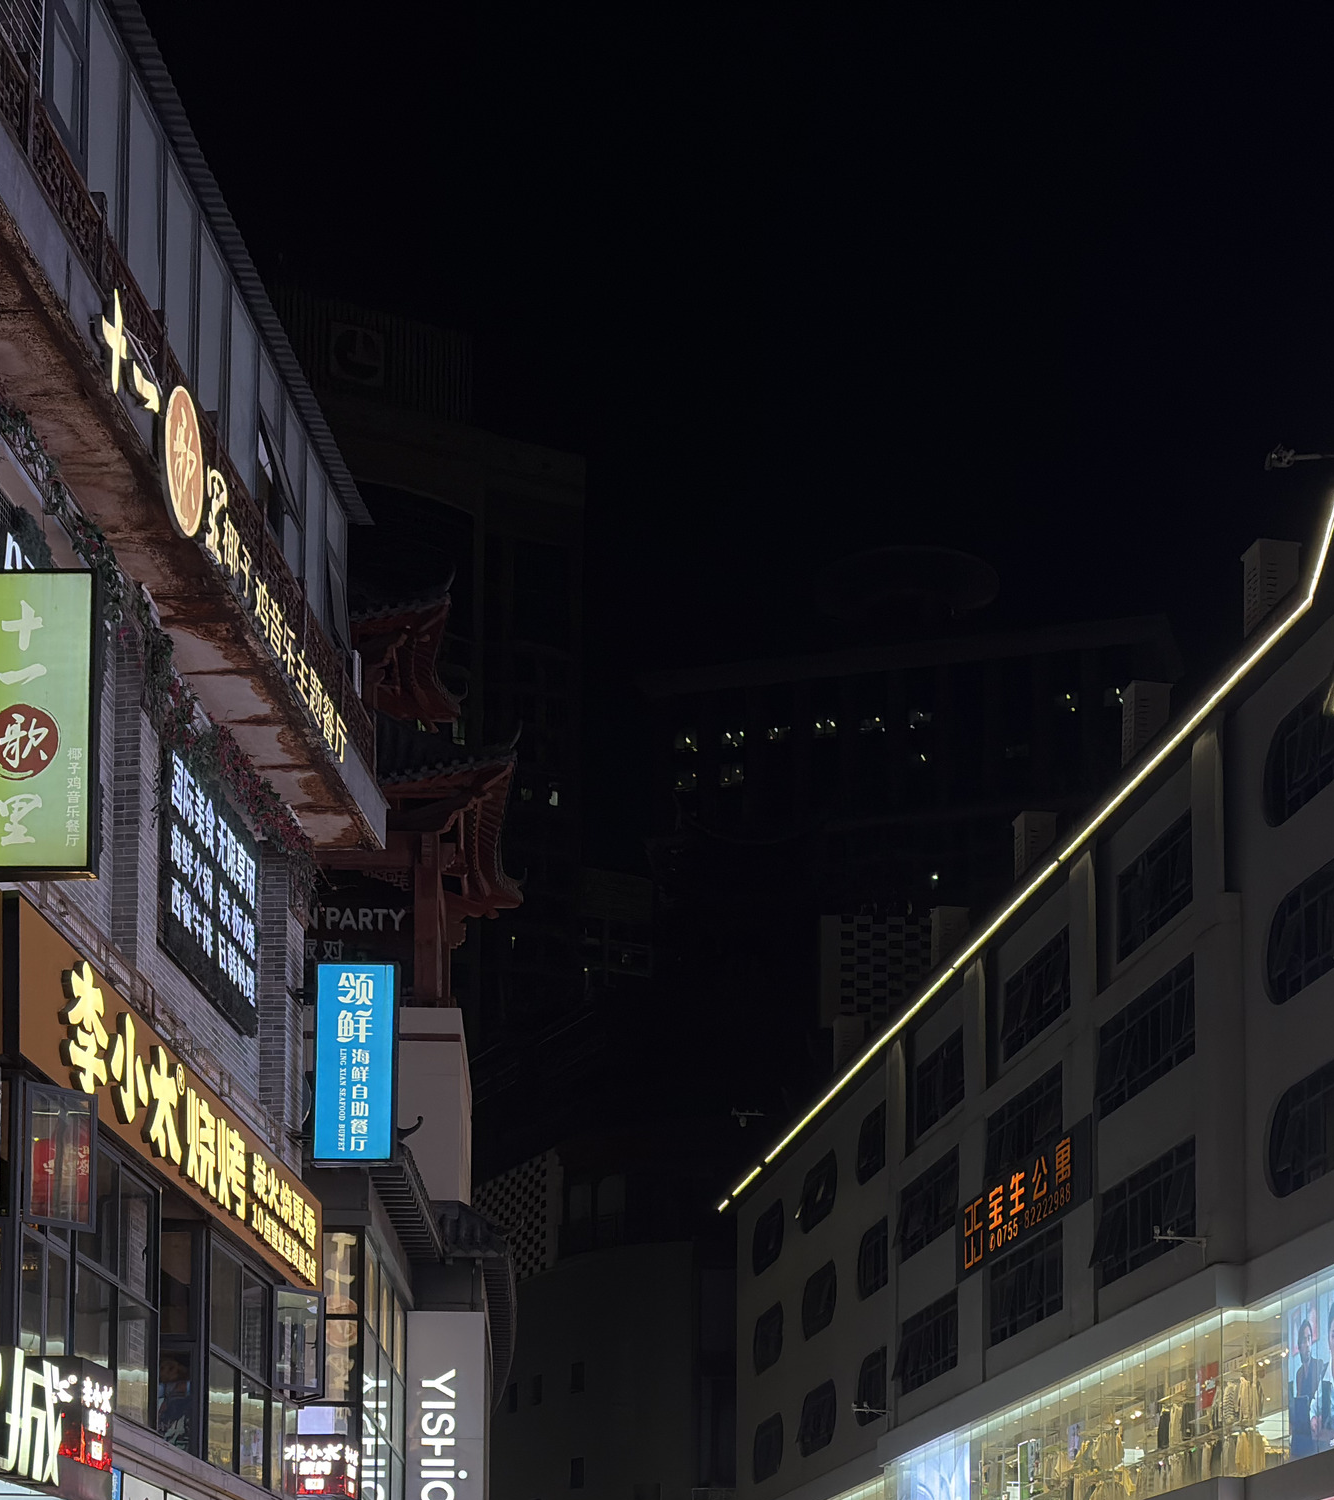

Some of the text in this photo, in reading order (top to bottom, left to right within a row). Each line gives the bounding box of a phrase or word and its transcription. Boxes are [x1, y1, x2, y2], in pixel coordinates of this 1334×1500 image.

[101, 288, 229, 565] 十一歌里
[222, 515, 348, 765] 椰子鸡音乐主题餐厅
[65, 746, 83, 848] 椰子鸡音乐餐厅
[171, 750, 256, 910] 国际美食 无限享用
[170, 822, 256, 961] 海鲜火锅 铁板烧
[170, 877, 256, 1008] 西餐牛排 日韩料理
[326, 907, 407, 932] PARTY
[336, 973, 375, 1043] 领鲜
[339, 1048, 347, 1066] LING
[339, 1067, 347, 1086] XIAN
[350, 1049, 370, 1152] 海鲜自助餐厅
[186, 1085, 247, 1221] 烧烤
[988, 1136, 1072, 1231] 宝生公寓
